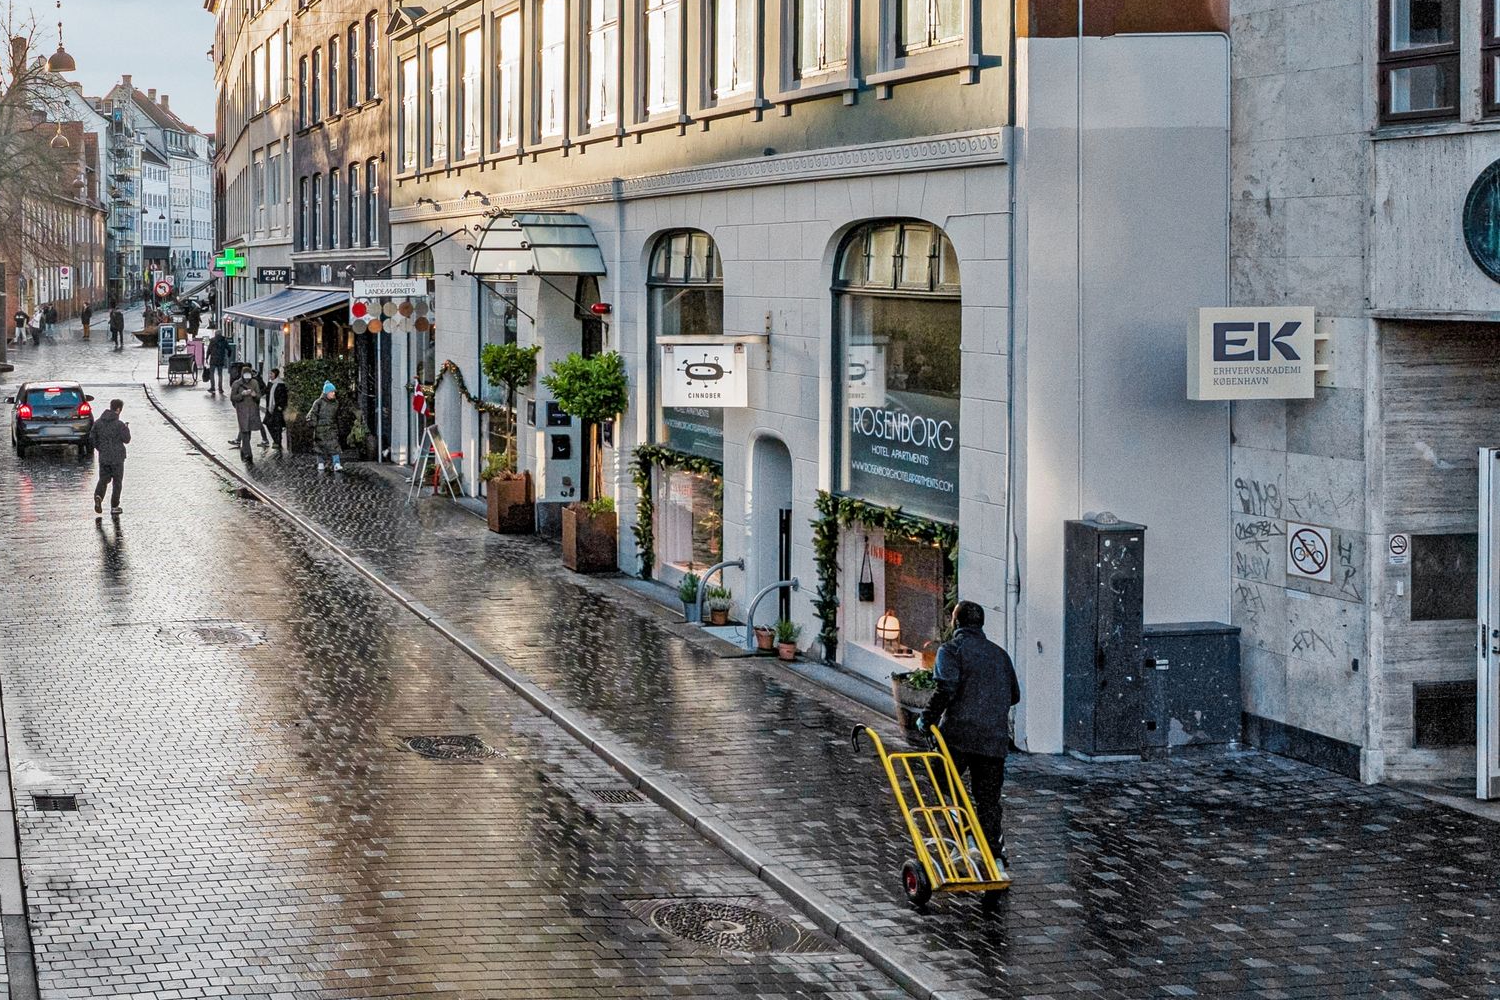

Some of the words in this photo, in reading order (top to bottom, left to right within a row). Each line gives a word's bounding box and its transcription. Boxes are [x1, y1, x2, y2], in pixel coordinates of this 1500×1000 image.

[1213, 321, 1301, 361] EK
[1213, 366, 1301, 375] ERHVERVSAKADEMI
[1213, 376, 1269, 386] KØBENHAVN
[853, 406, 954, 451] ROSENBORG
[872, 445, 890, 458] HOTEL
[891, 449, 930, 466] APARTMENTS
